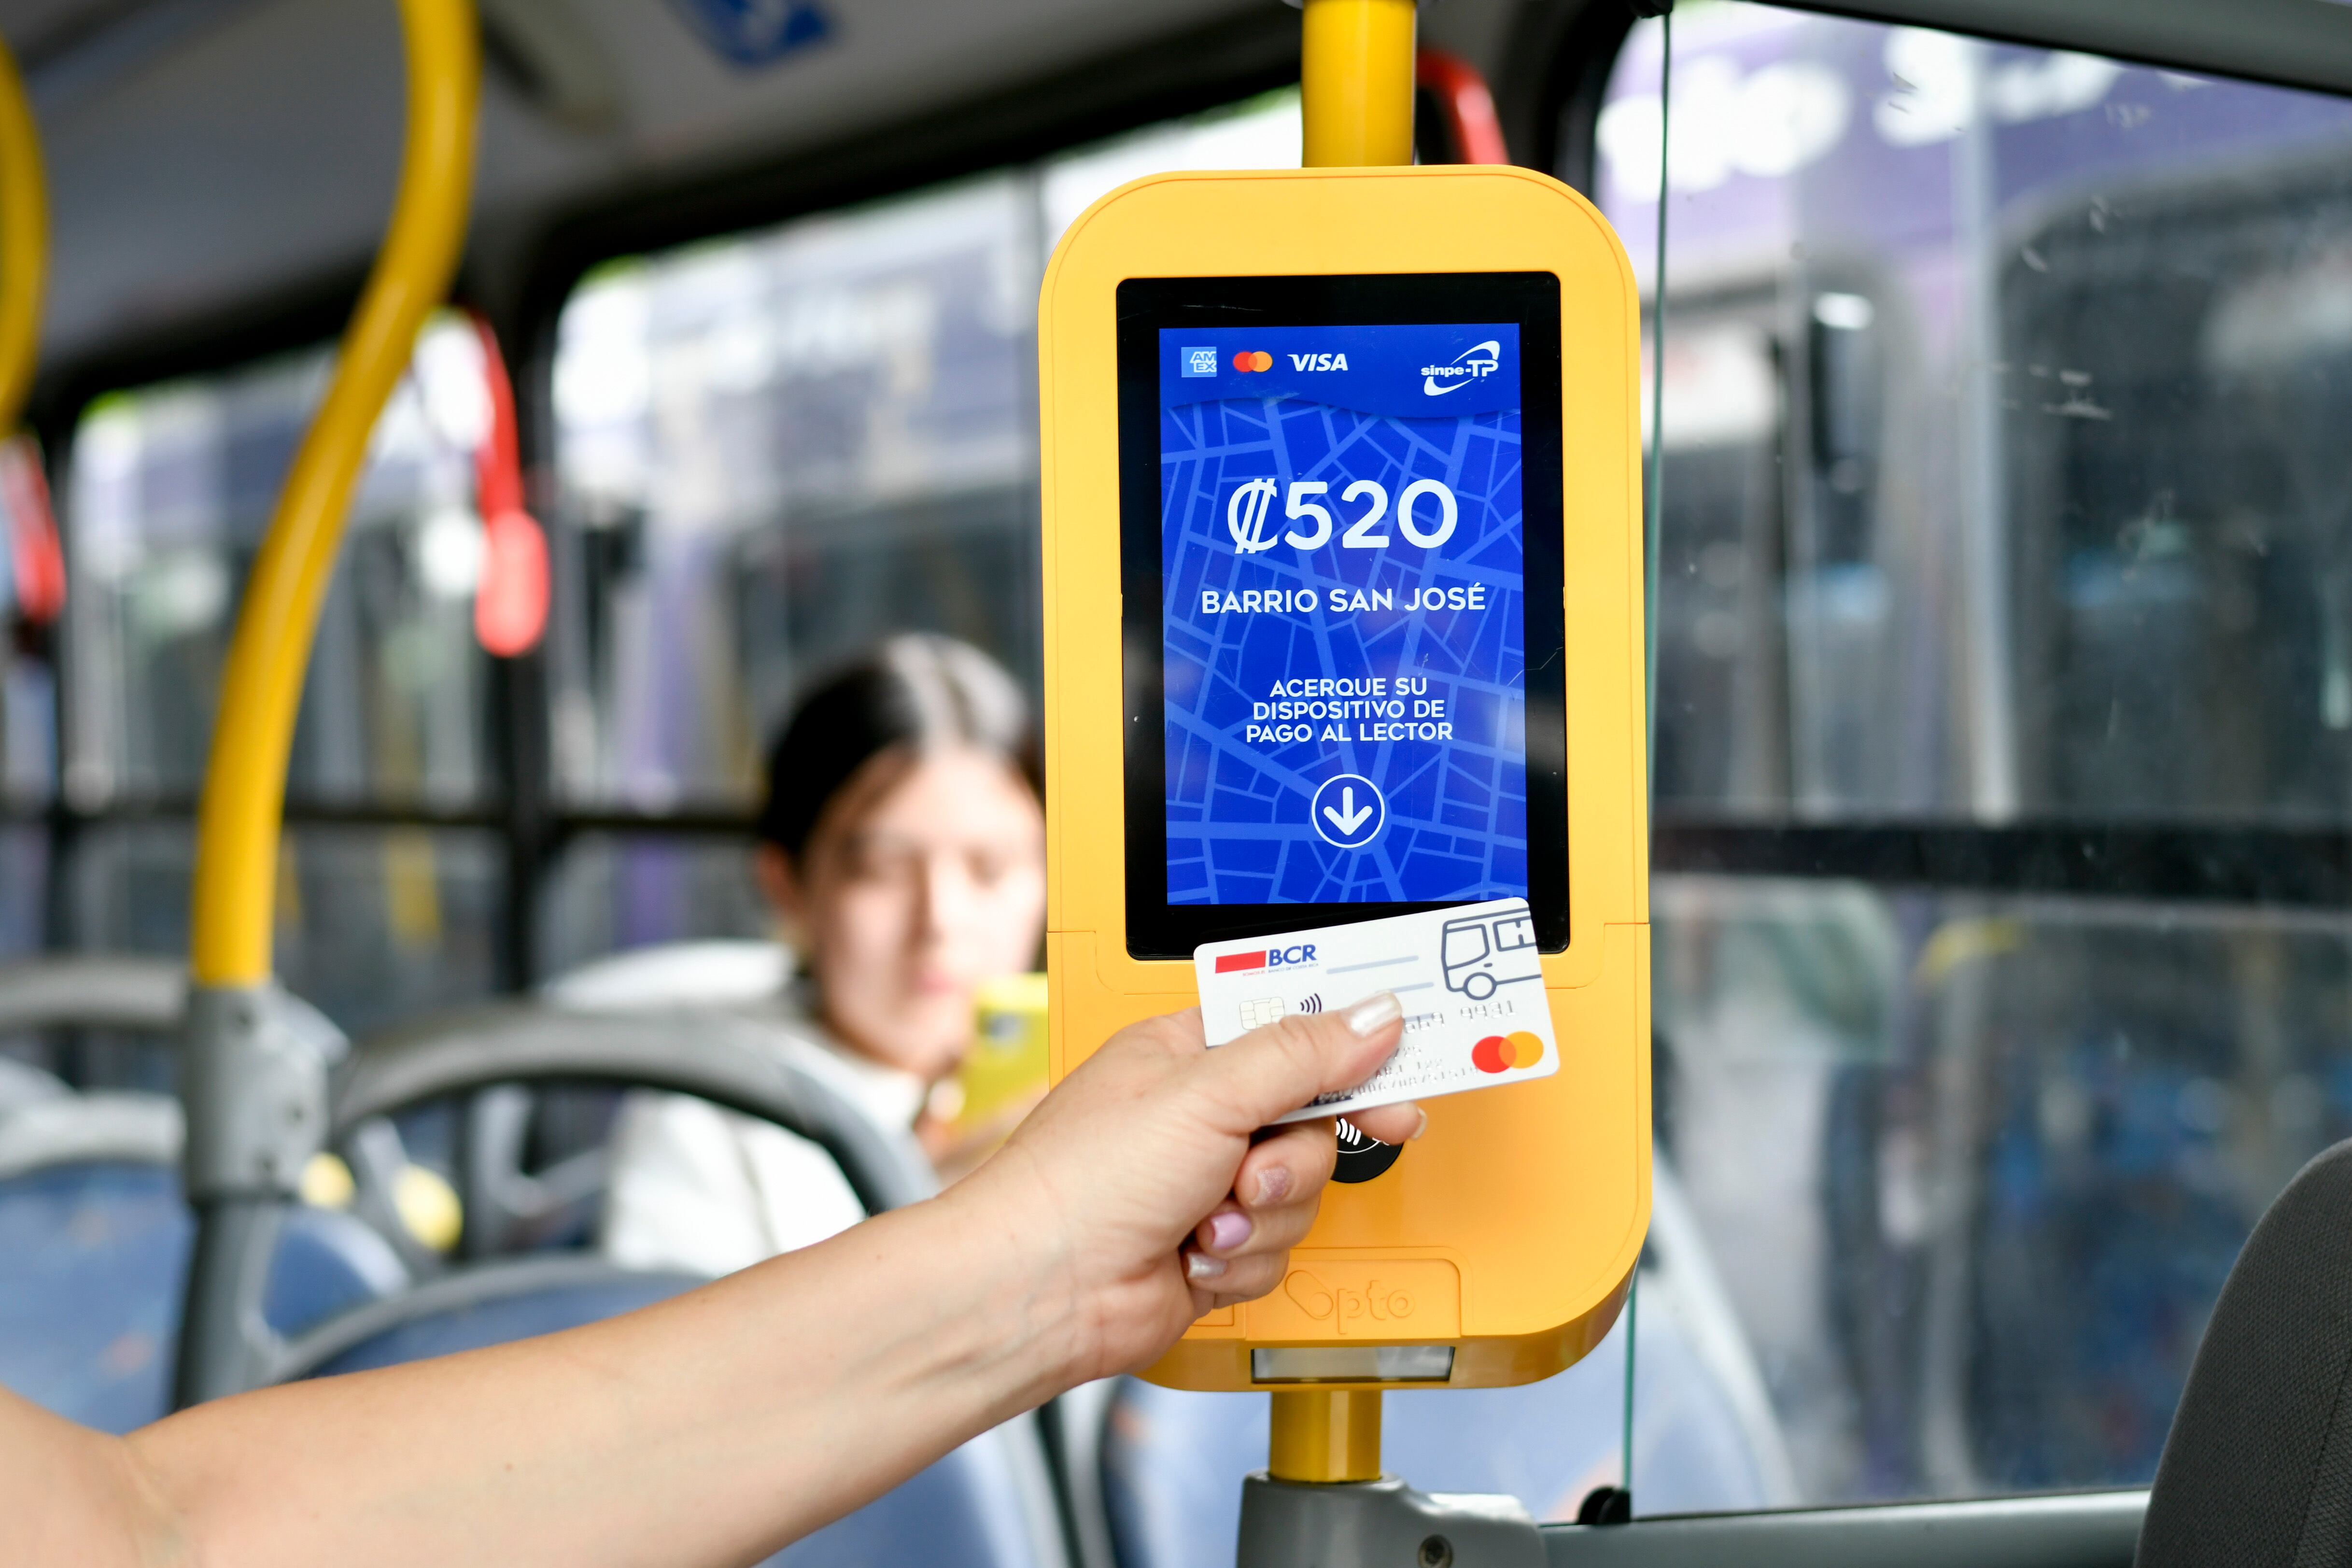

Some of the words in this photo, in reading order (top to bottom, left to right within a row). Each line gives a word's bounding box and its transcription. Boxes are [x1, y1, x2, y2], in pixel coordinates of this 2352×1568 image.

[1287, 353, 1349, 372] VISA
[1421, 359, 1499, 378] sinpe-TP
[1201, 590, 1319, 614] BARRIO
[1329, 588, 1393, 612] SAN
[1404, 582, 1486, 611] JOSÉ
[1269, 678, 1387, 697] ACERQUE
[1395, 677, 1427, 696] SU
[1253, 700, 1406, 720] DISPOSITIVO
[1414, 699, 1445, 718] DE
[1246, 723, 1312, 743] PAGO
[1320, 723, 1352, 742] AL
[1360, 722, 1453, 741] LECTOR
[1268, 944, 1317, 967] BCR
